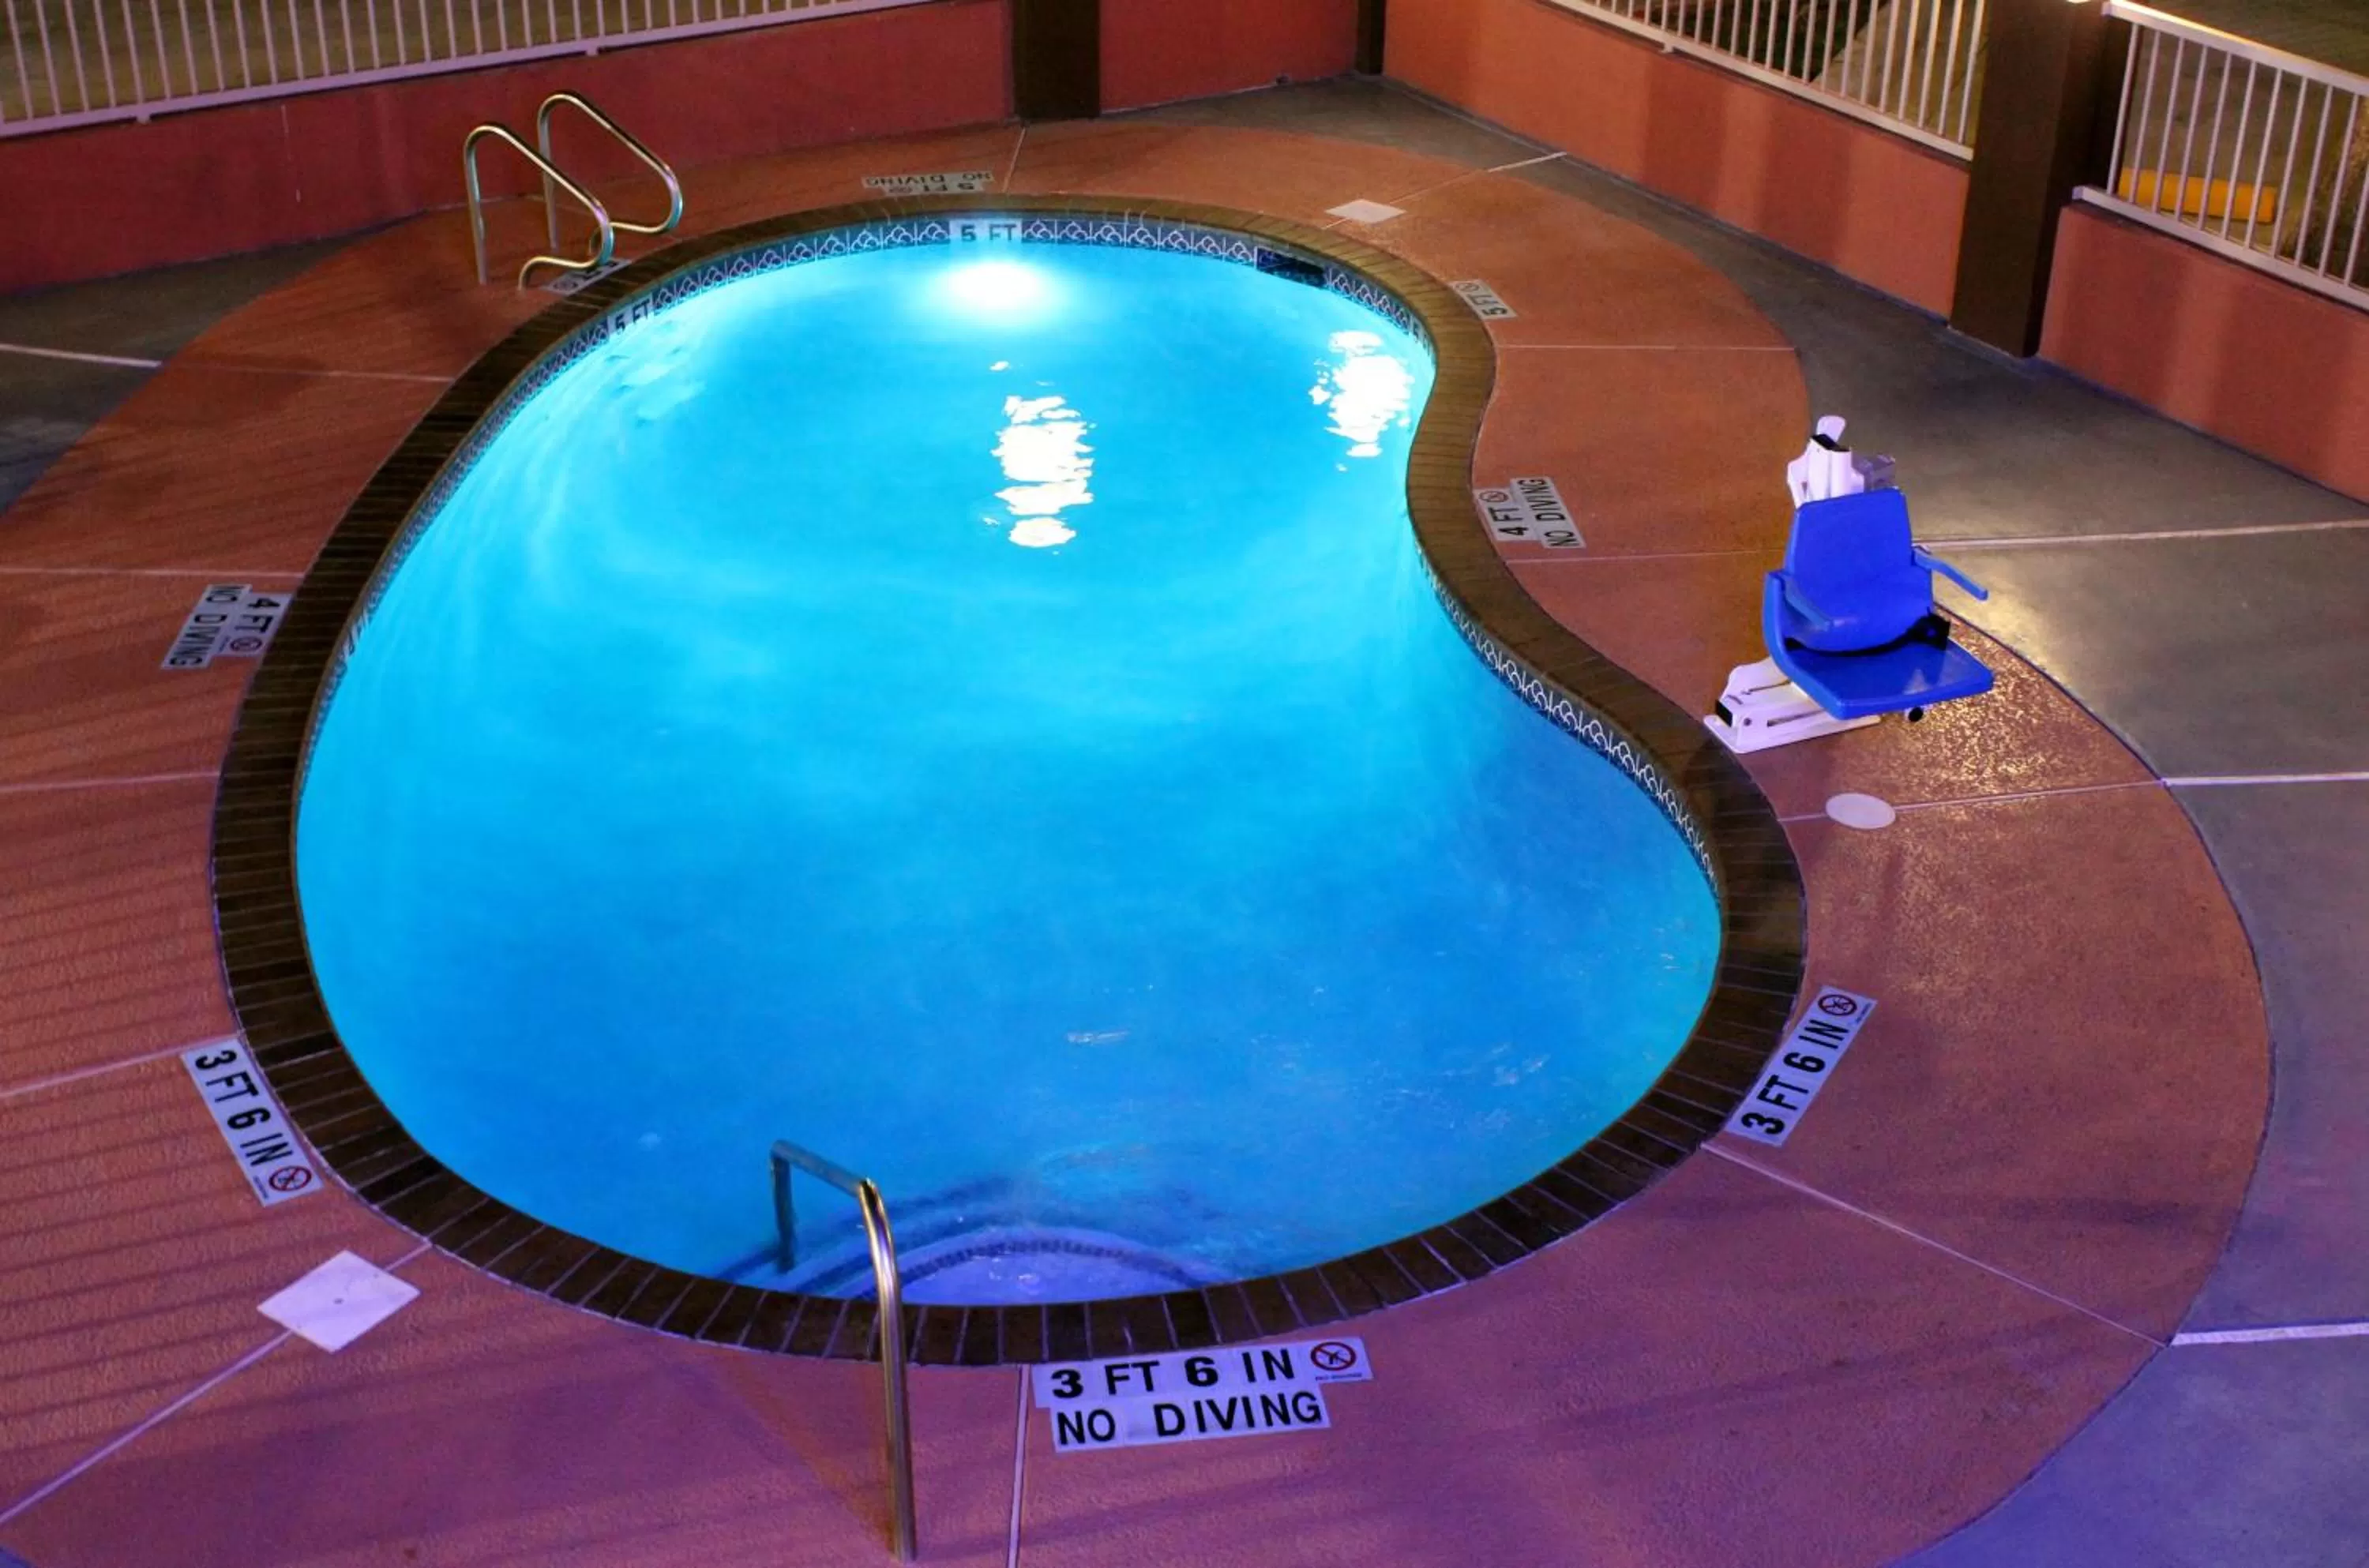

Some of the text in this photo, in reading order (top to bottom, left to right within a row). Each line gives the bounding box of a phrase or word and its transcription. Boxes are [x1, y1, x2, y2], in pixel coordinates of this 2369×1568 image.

[960, 223, 1016, 242] 5 FT
[615, 298, 650, 332] 5 FT
[1466, 294, 1507, 317] 5 FT
[1488, 507, 1530, 536] 4 FT
[1517, 478, 1580, 546] NO DIVING
[169, 585, 245, 666] NO DIVING
[234, 598, 281, 633] 4 FT
[1741, 1018, 1850, 1135] 3 FT 6 IN
[195, 1049, 294, 1166] 3 FT 6 IN
[1051, 1347, 1296, 1399] 3 FT 6 IN
[1056, 1391, 1322, 1446] NO DIVING
